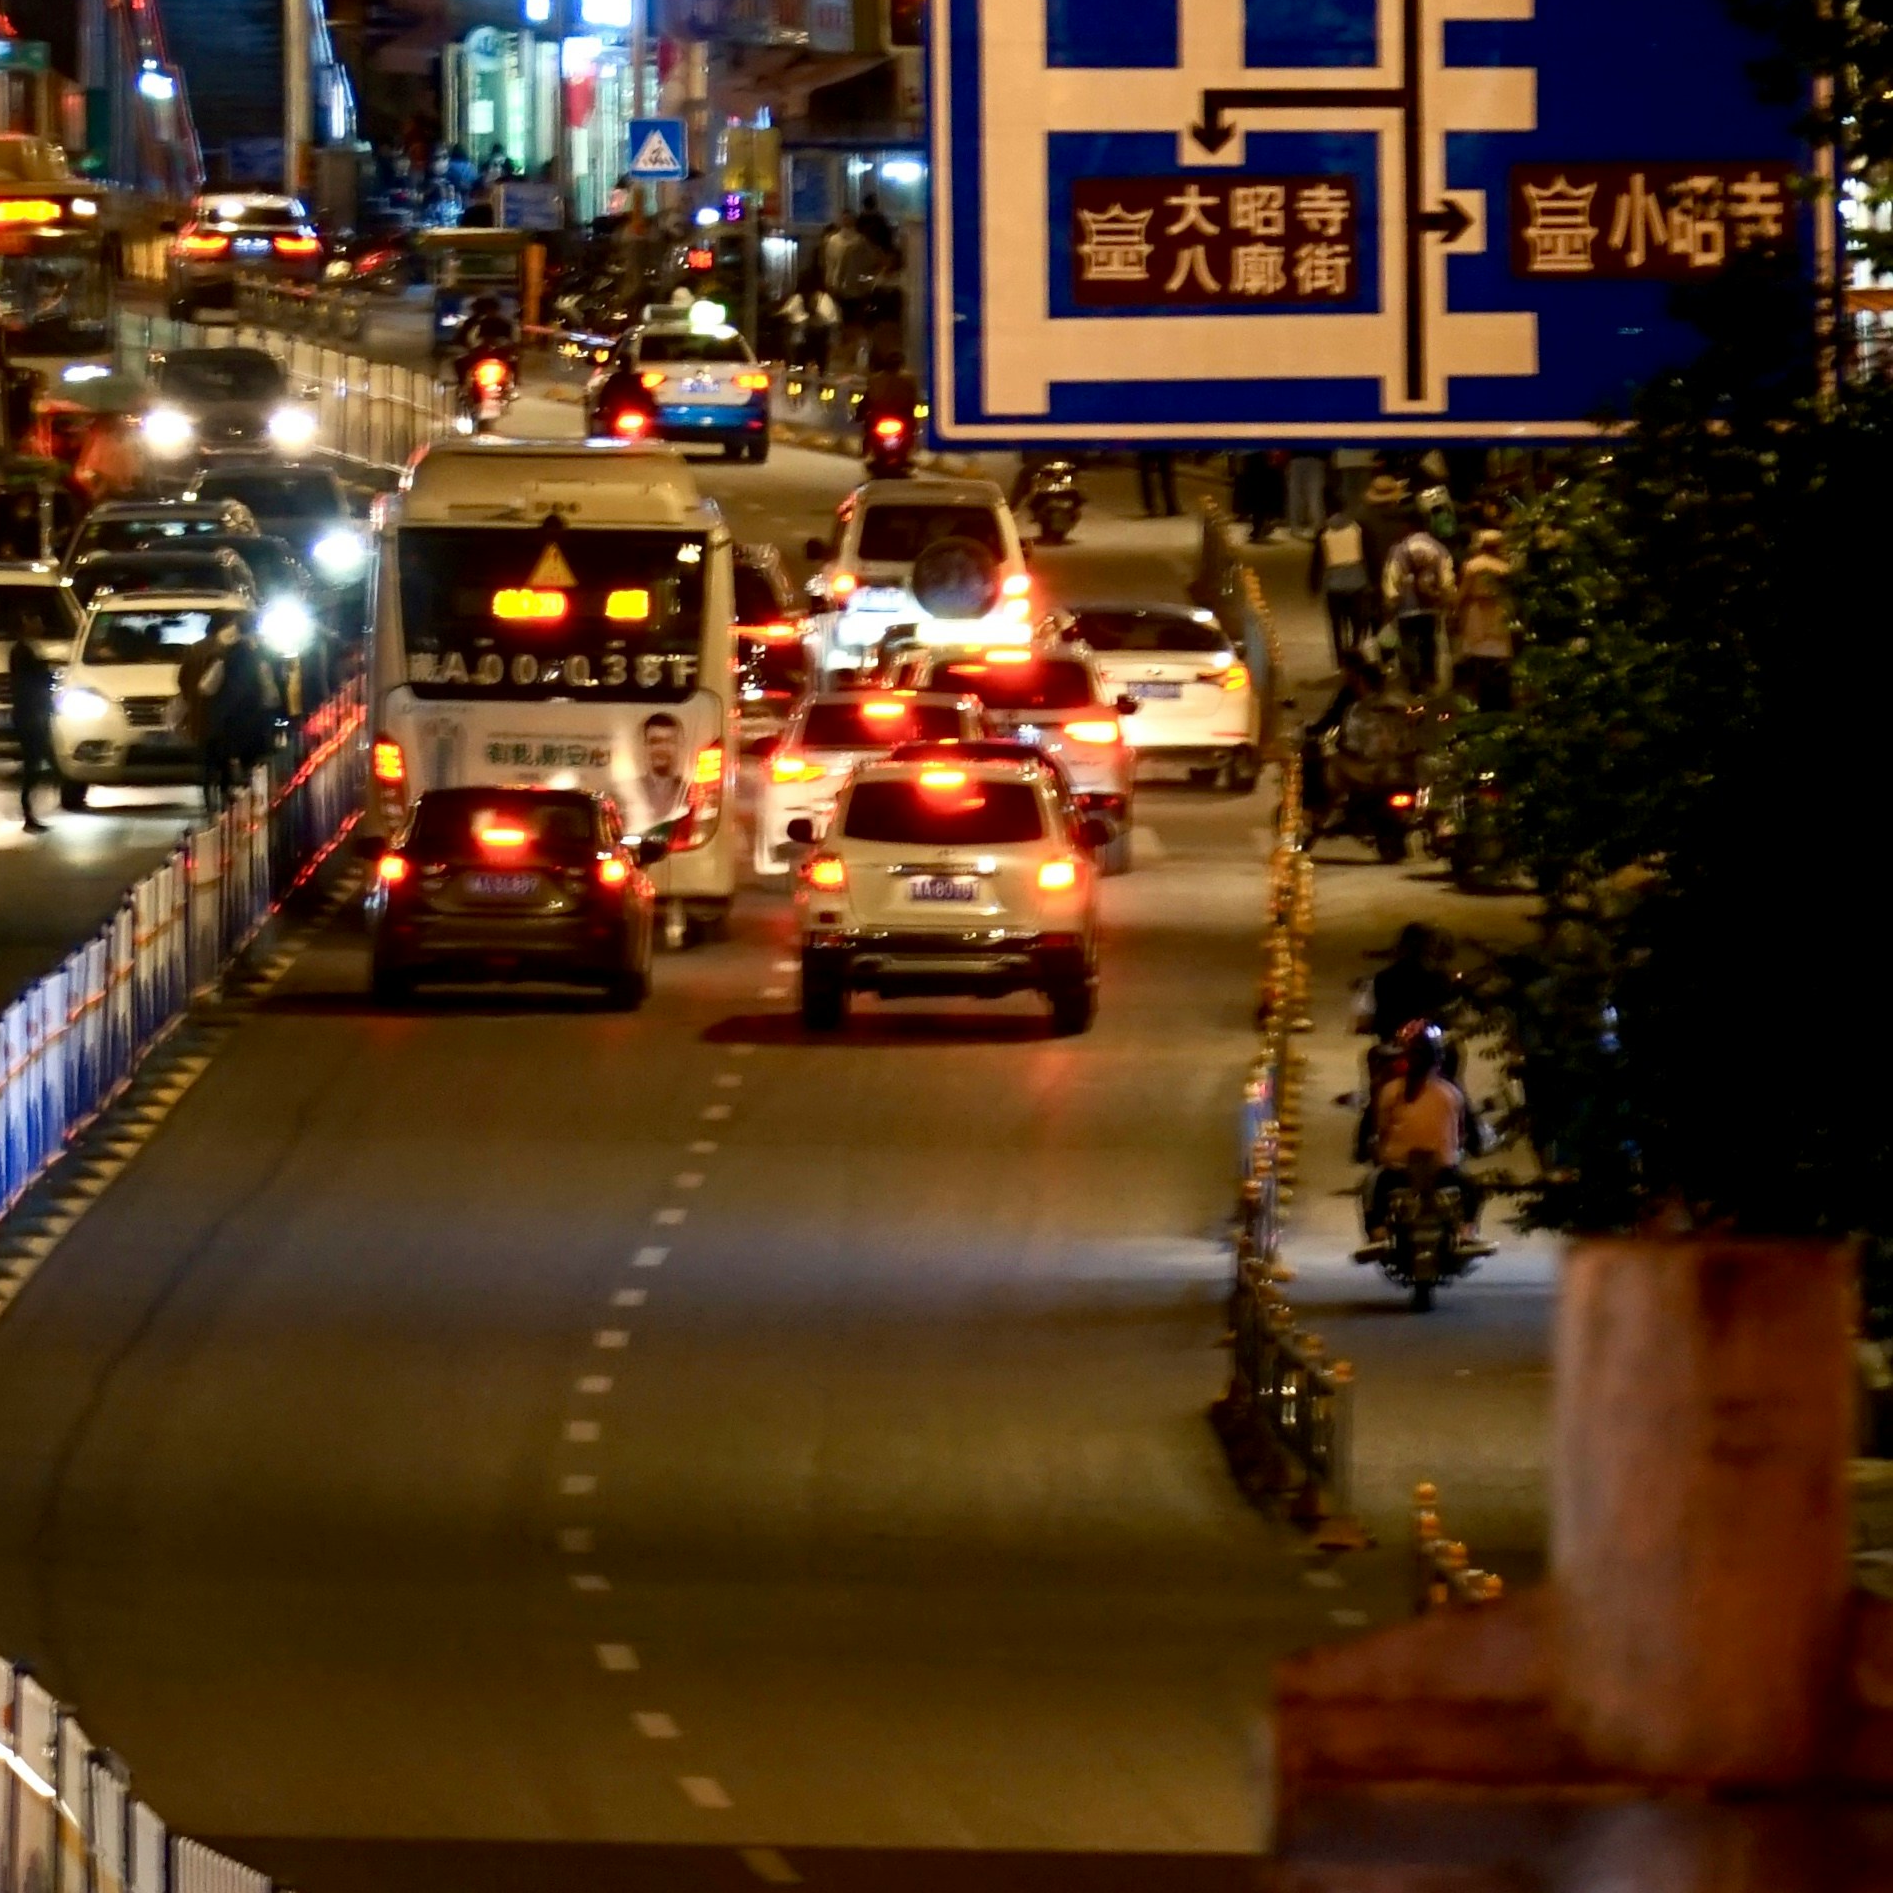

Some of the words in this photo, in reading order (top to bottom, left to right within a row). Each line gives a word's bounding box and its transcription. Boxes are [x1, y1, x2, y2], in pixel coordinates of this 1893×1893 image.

[1163, 183, 1351, 237] 大昭寺
[1607, 170, 1784, 270] 小昭寺
[1163, 242, 1353, 296] 八廓街
